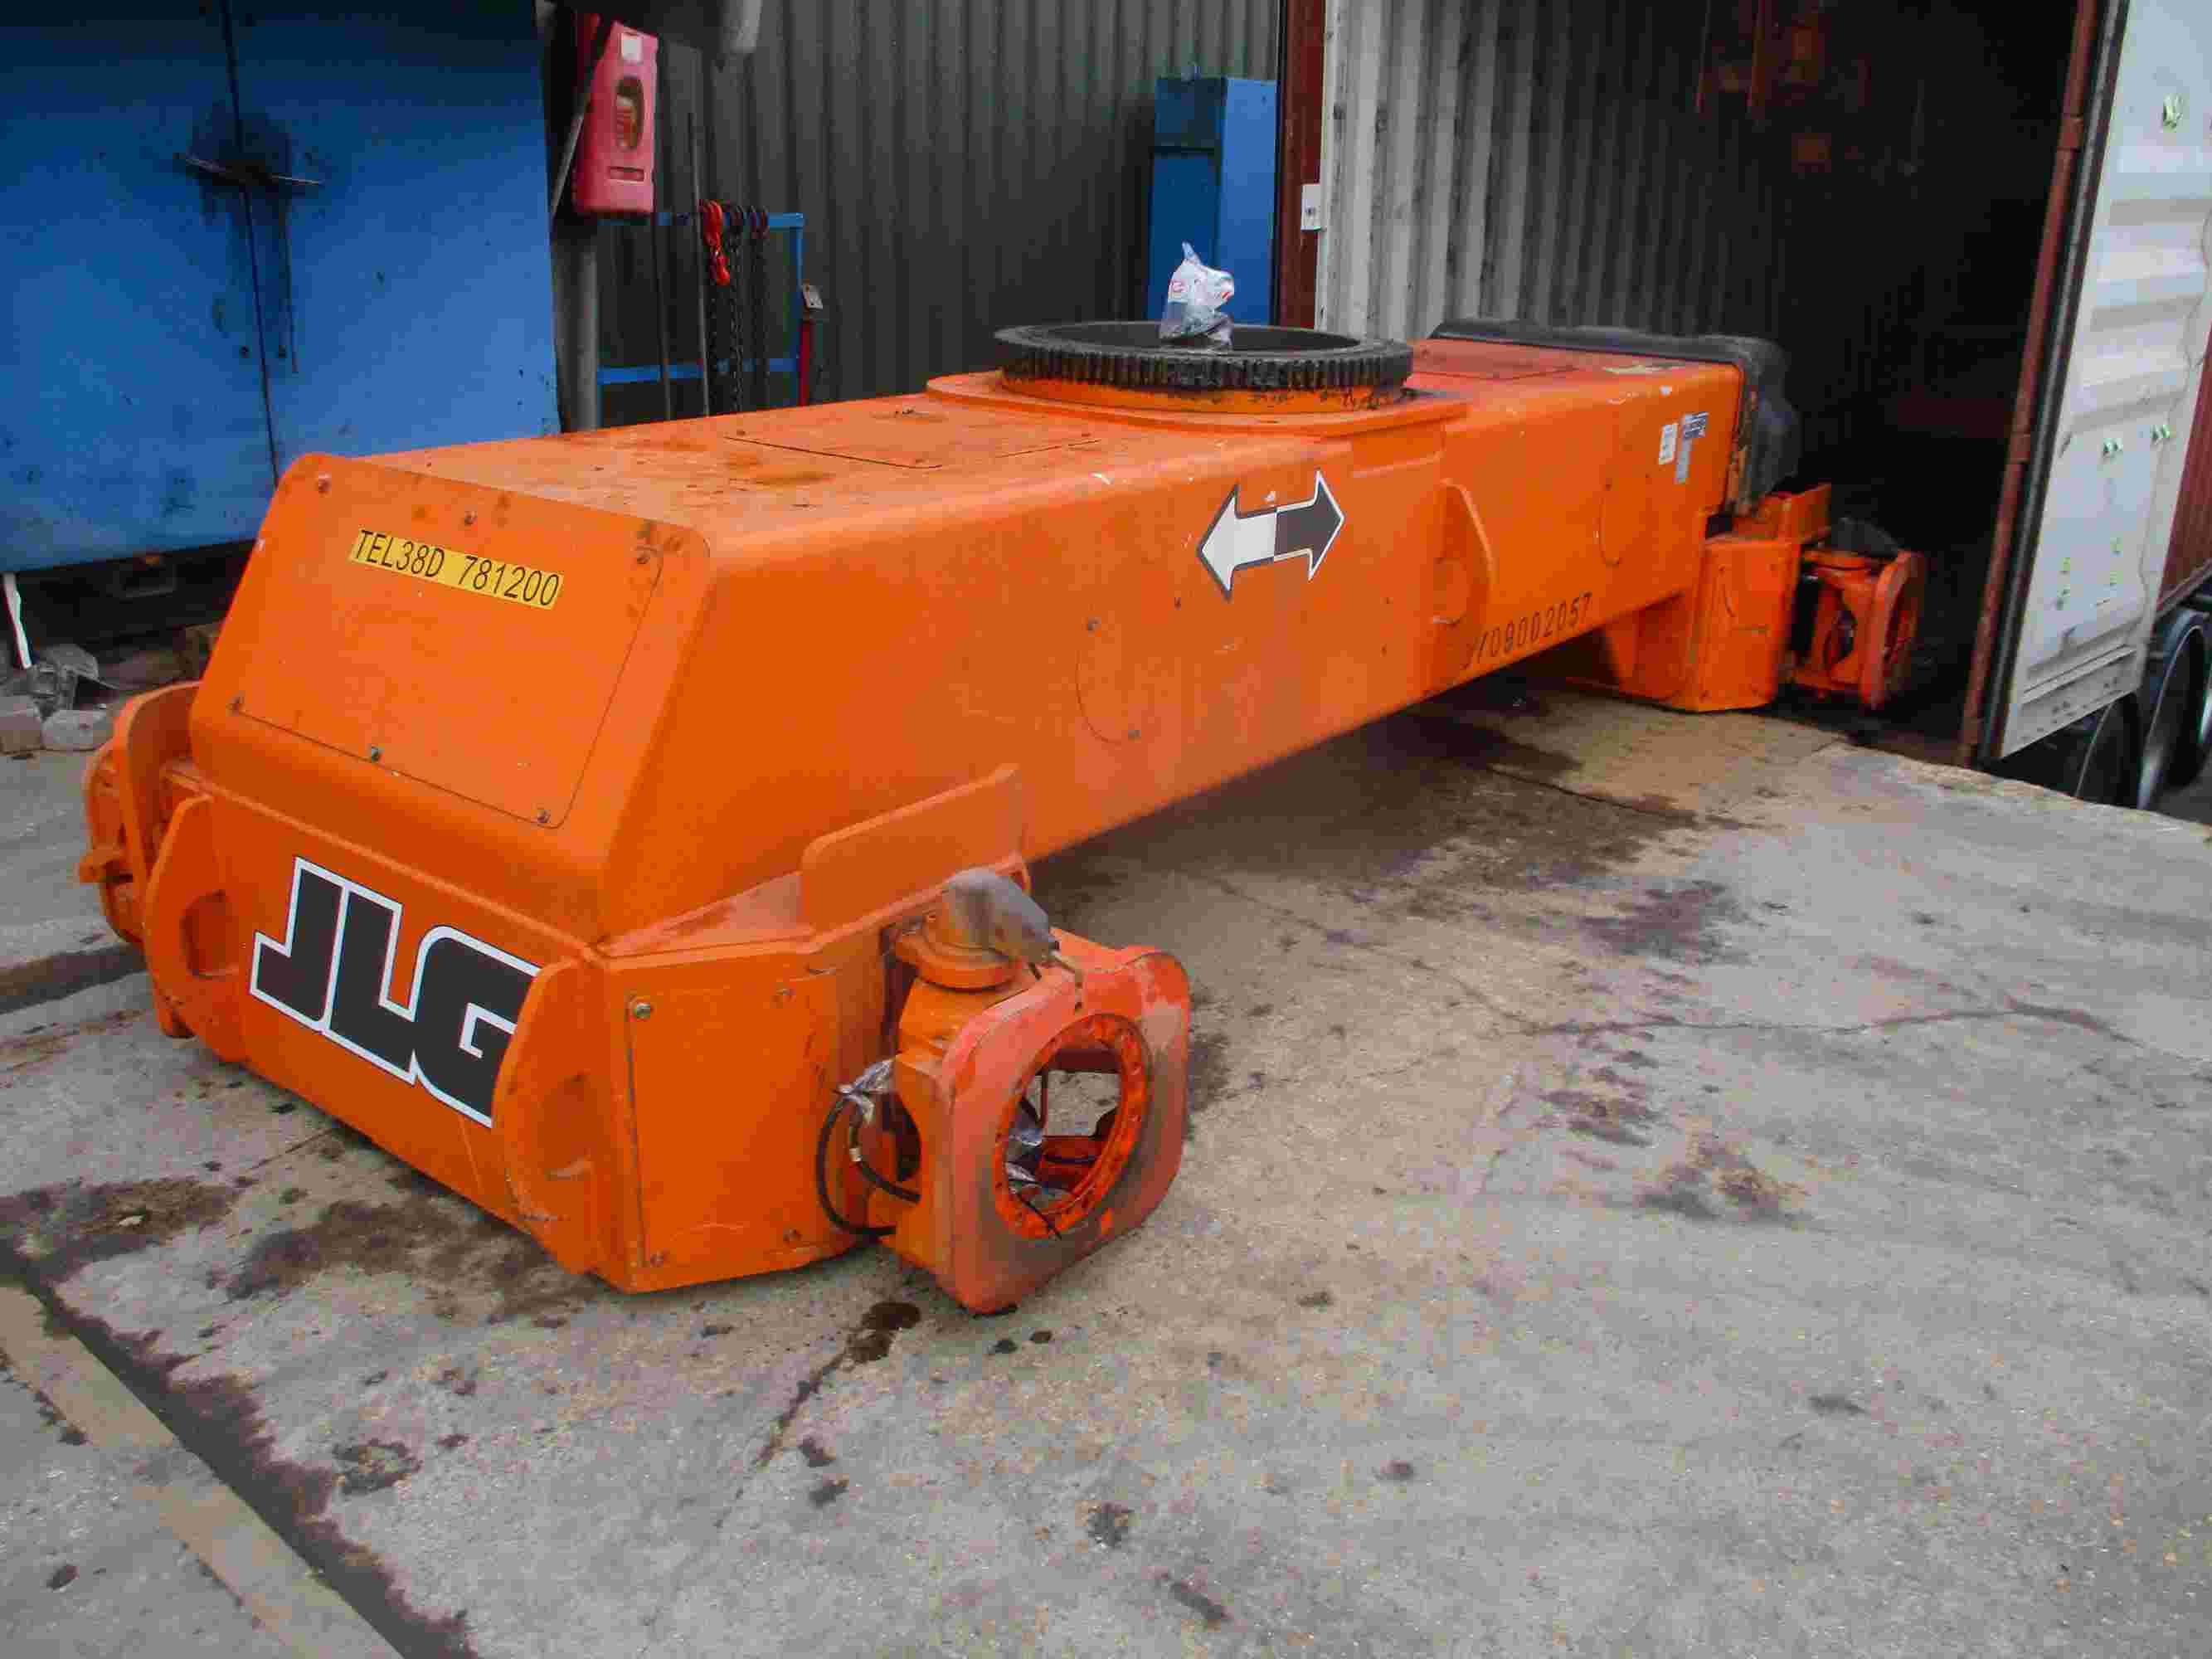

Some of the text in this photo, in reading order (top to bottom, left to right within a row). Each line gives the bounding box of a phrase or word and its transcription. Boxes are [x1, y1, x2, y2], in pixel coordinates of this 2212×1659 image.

[354, 528, 560, 606] TEL38D 781200
[250, 856, 544, 1128] JLG
